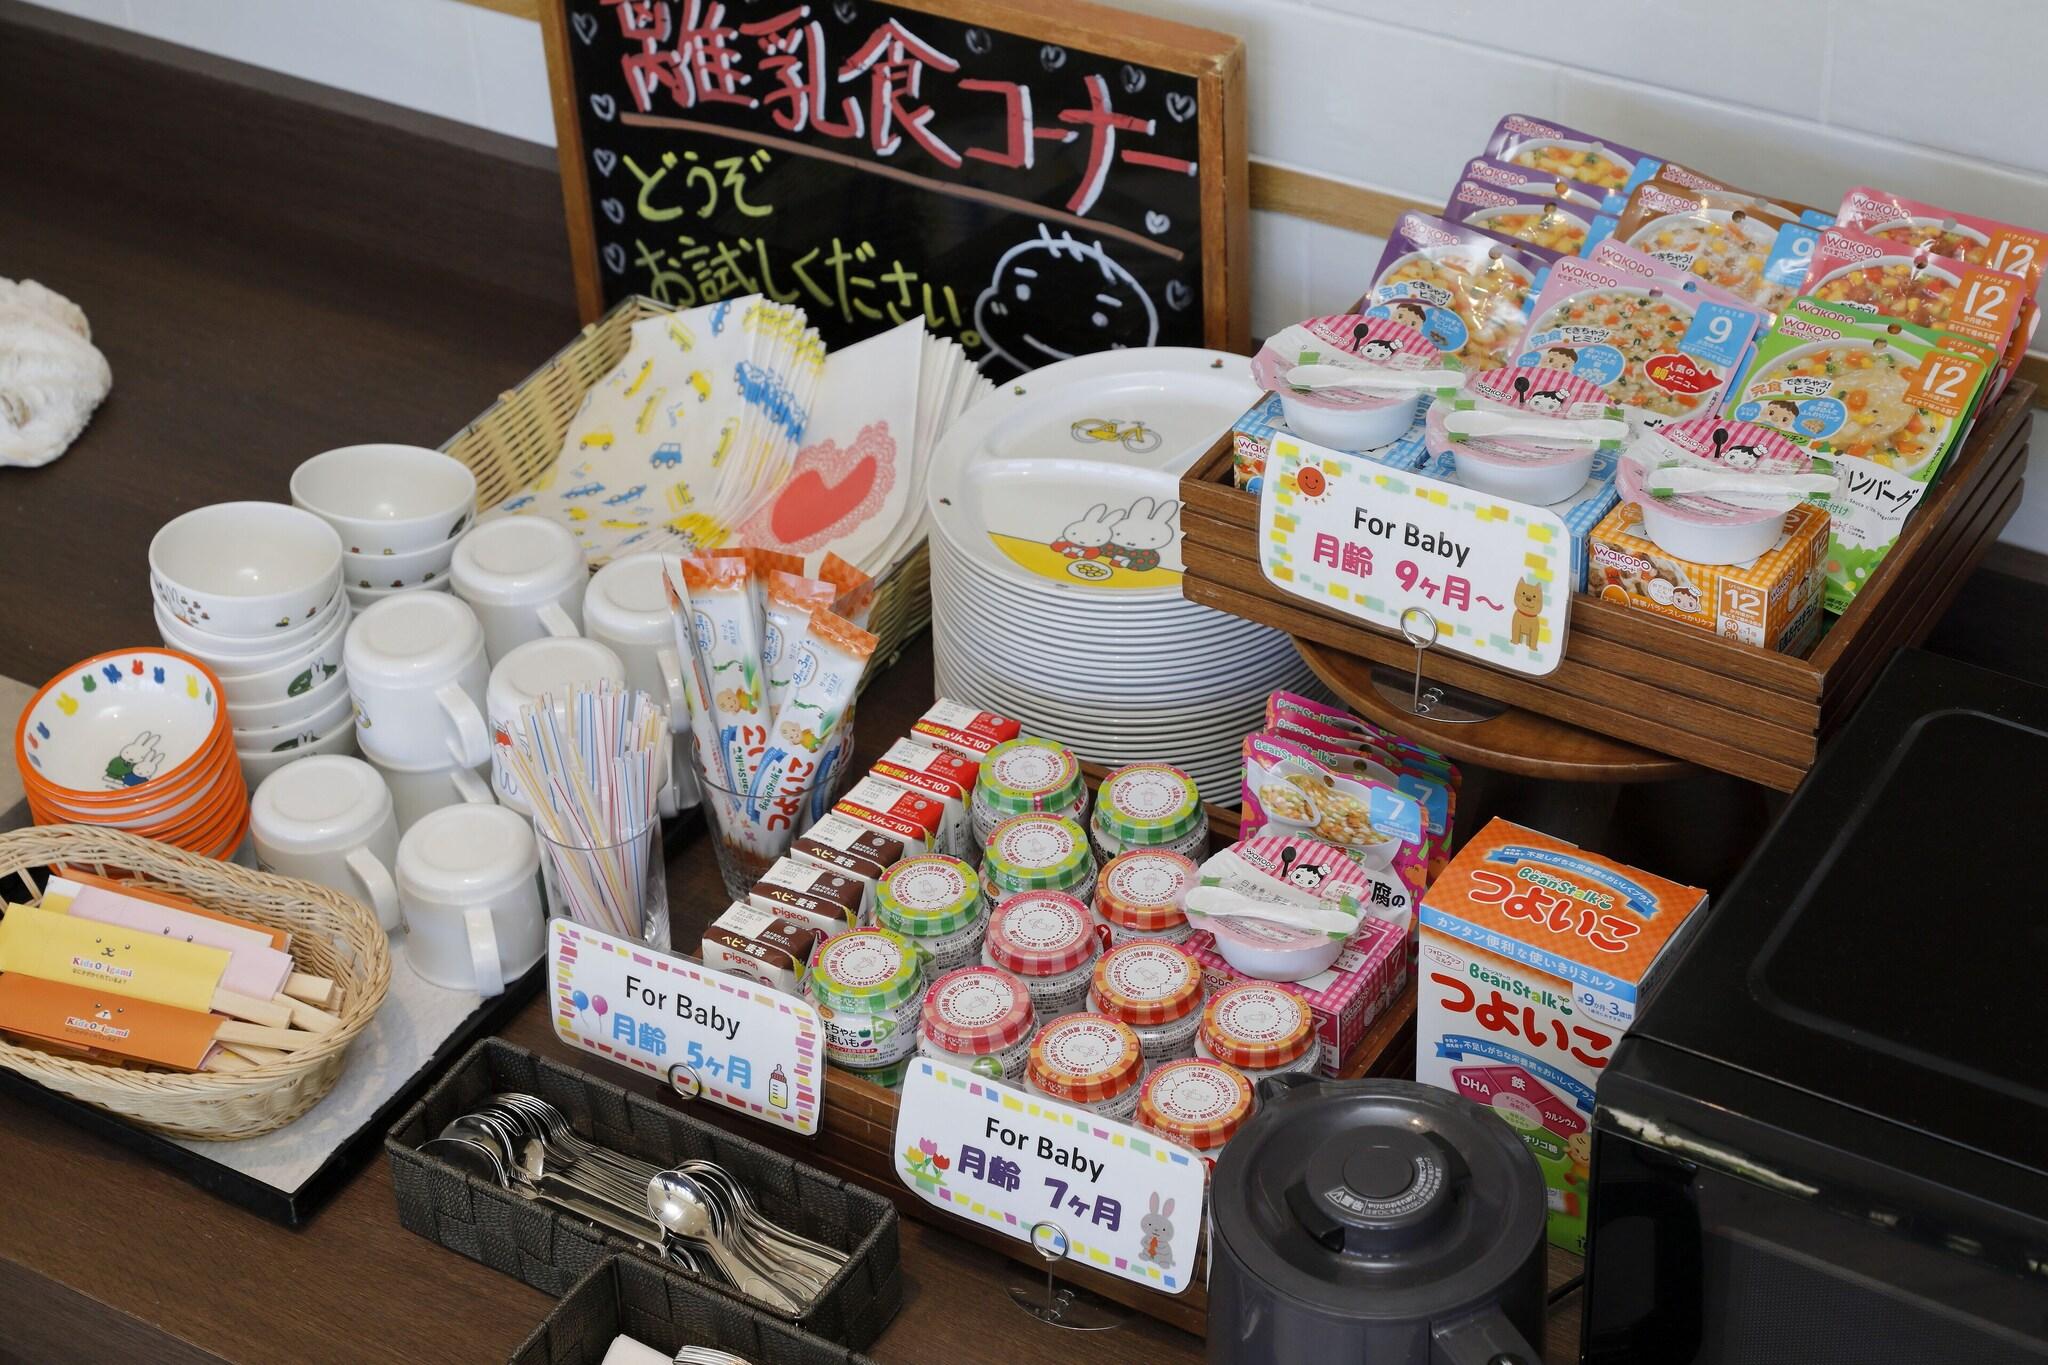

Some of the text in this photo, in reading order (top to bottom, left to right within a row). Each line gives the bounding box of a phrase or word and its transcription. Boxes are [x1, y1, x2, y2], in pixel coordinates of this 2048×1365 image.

[622, 149, 774, 220] どうぞ
[1993, 240, 2035, 279] 12
[1963, 281, 2006, 320] 12
[1703, 316, 1733, 344] 9
[1666, 361, 1696, 377] 人気の
[1922, 362, 1967, 398] 12
[1313, 532, 1374, 579] 月齢
[1354, 506, 1471, 568] For Baby
[1725, 588, 1762, 617] 12
[1725, 621, 1739, 632] 90
[767, 757, 814, 831] つよいこ
[1386, 795, 1405, 820] 7
[811, 847, 856, 868] ベビー麦茶
[770, 890, 818, 910] ベビー麦茶
[1368, 879, 1406, 908] 腐の
[1518, 867, 1599, 905] BeanStalk
[1469, 870, 1641, 953] つよいこ
[721, 936, 767, 957] ベビー麦茶
[1427, 948, 1462, 965] フォローアップ
[1438, 916, 1616, 992] カンタン便利な使いきりミルク
[1469, 963, 1558, 1010] BeanStalk
[626, 975, 741, 1040] For Baby
[1430, 972, 1613, 1069] つよいこ
[875, 1020, 888, 1041] 5
[613, 1012, 751, 1090] 月齢 5ヶ月
[1460, 1074, 1491, 1096] DHA
[1511, 1075, 1526, 1092] 鉄
[1544, 1111, 1578, 1130] カルシウム
[985, 1116, 1105, 1183] For Baby
[957, 1144, 1122, 1232] 月齢 7ヶ月
